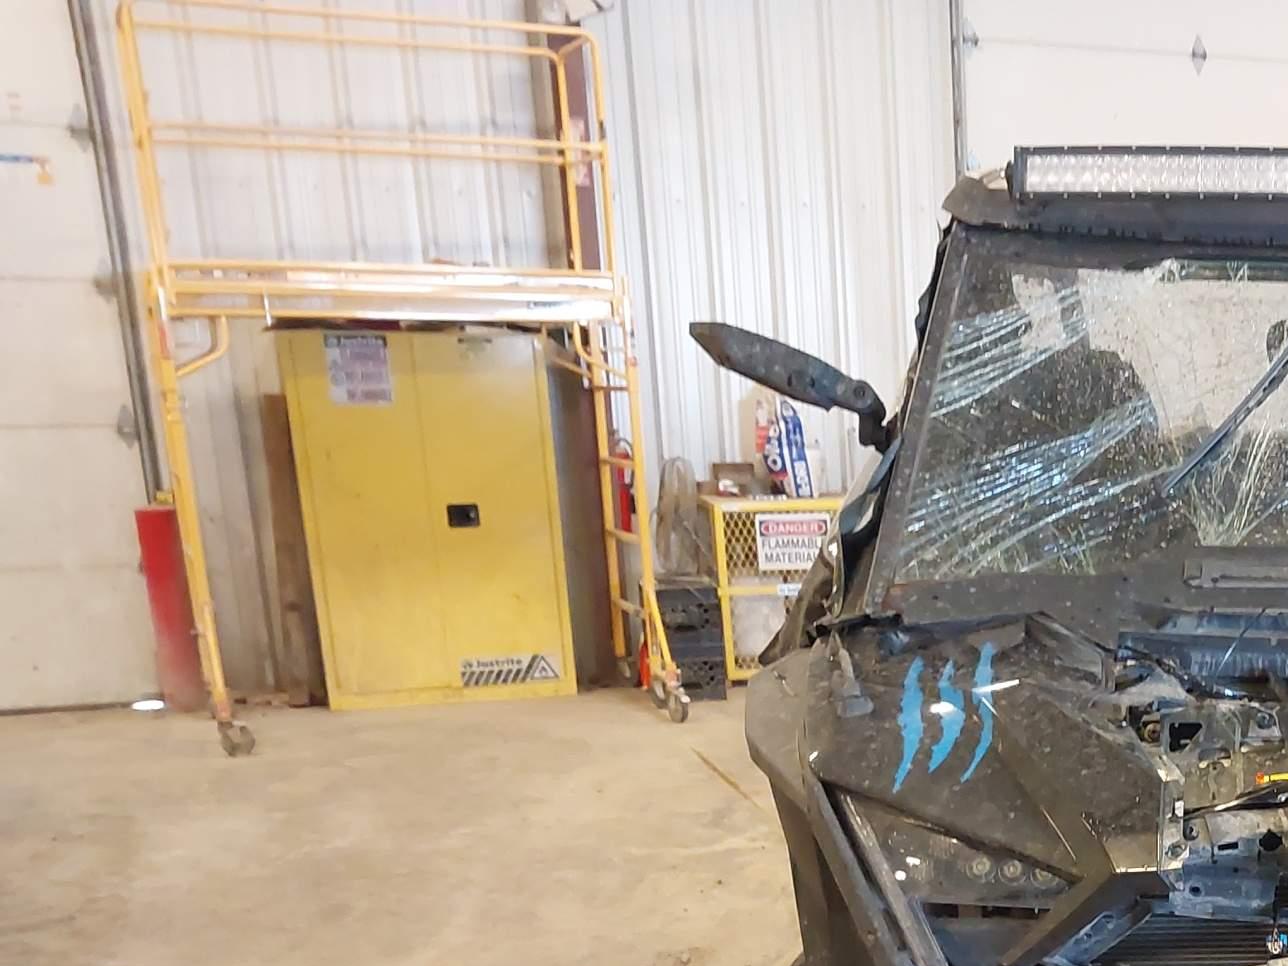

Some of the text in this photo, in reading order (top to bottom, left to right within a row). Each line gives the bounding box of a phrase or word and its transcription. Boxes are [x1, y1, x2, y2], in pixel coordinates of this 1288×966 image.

[768, 521, 818, 534] DANGER
[762, 537, 820, 549] FLAMMABL
[764, 551, 816, 563] MATERIAL
